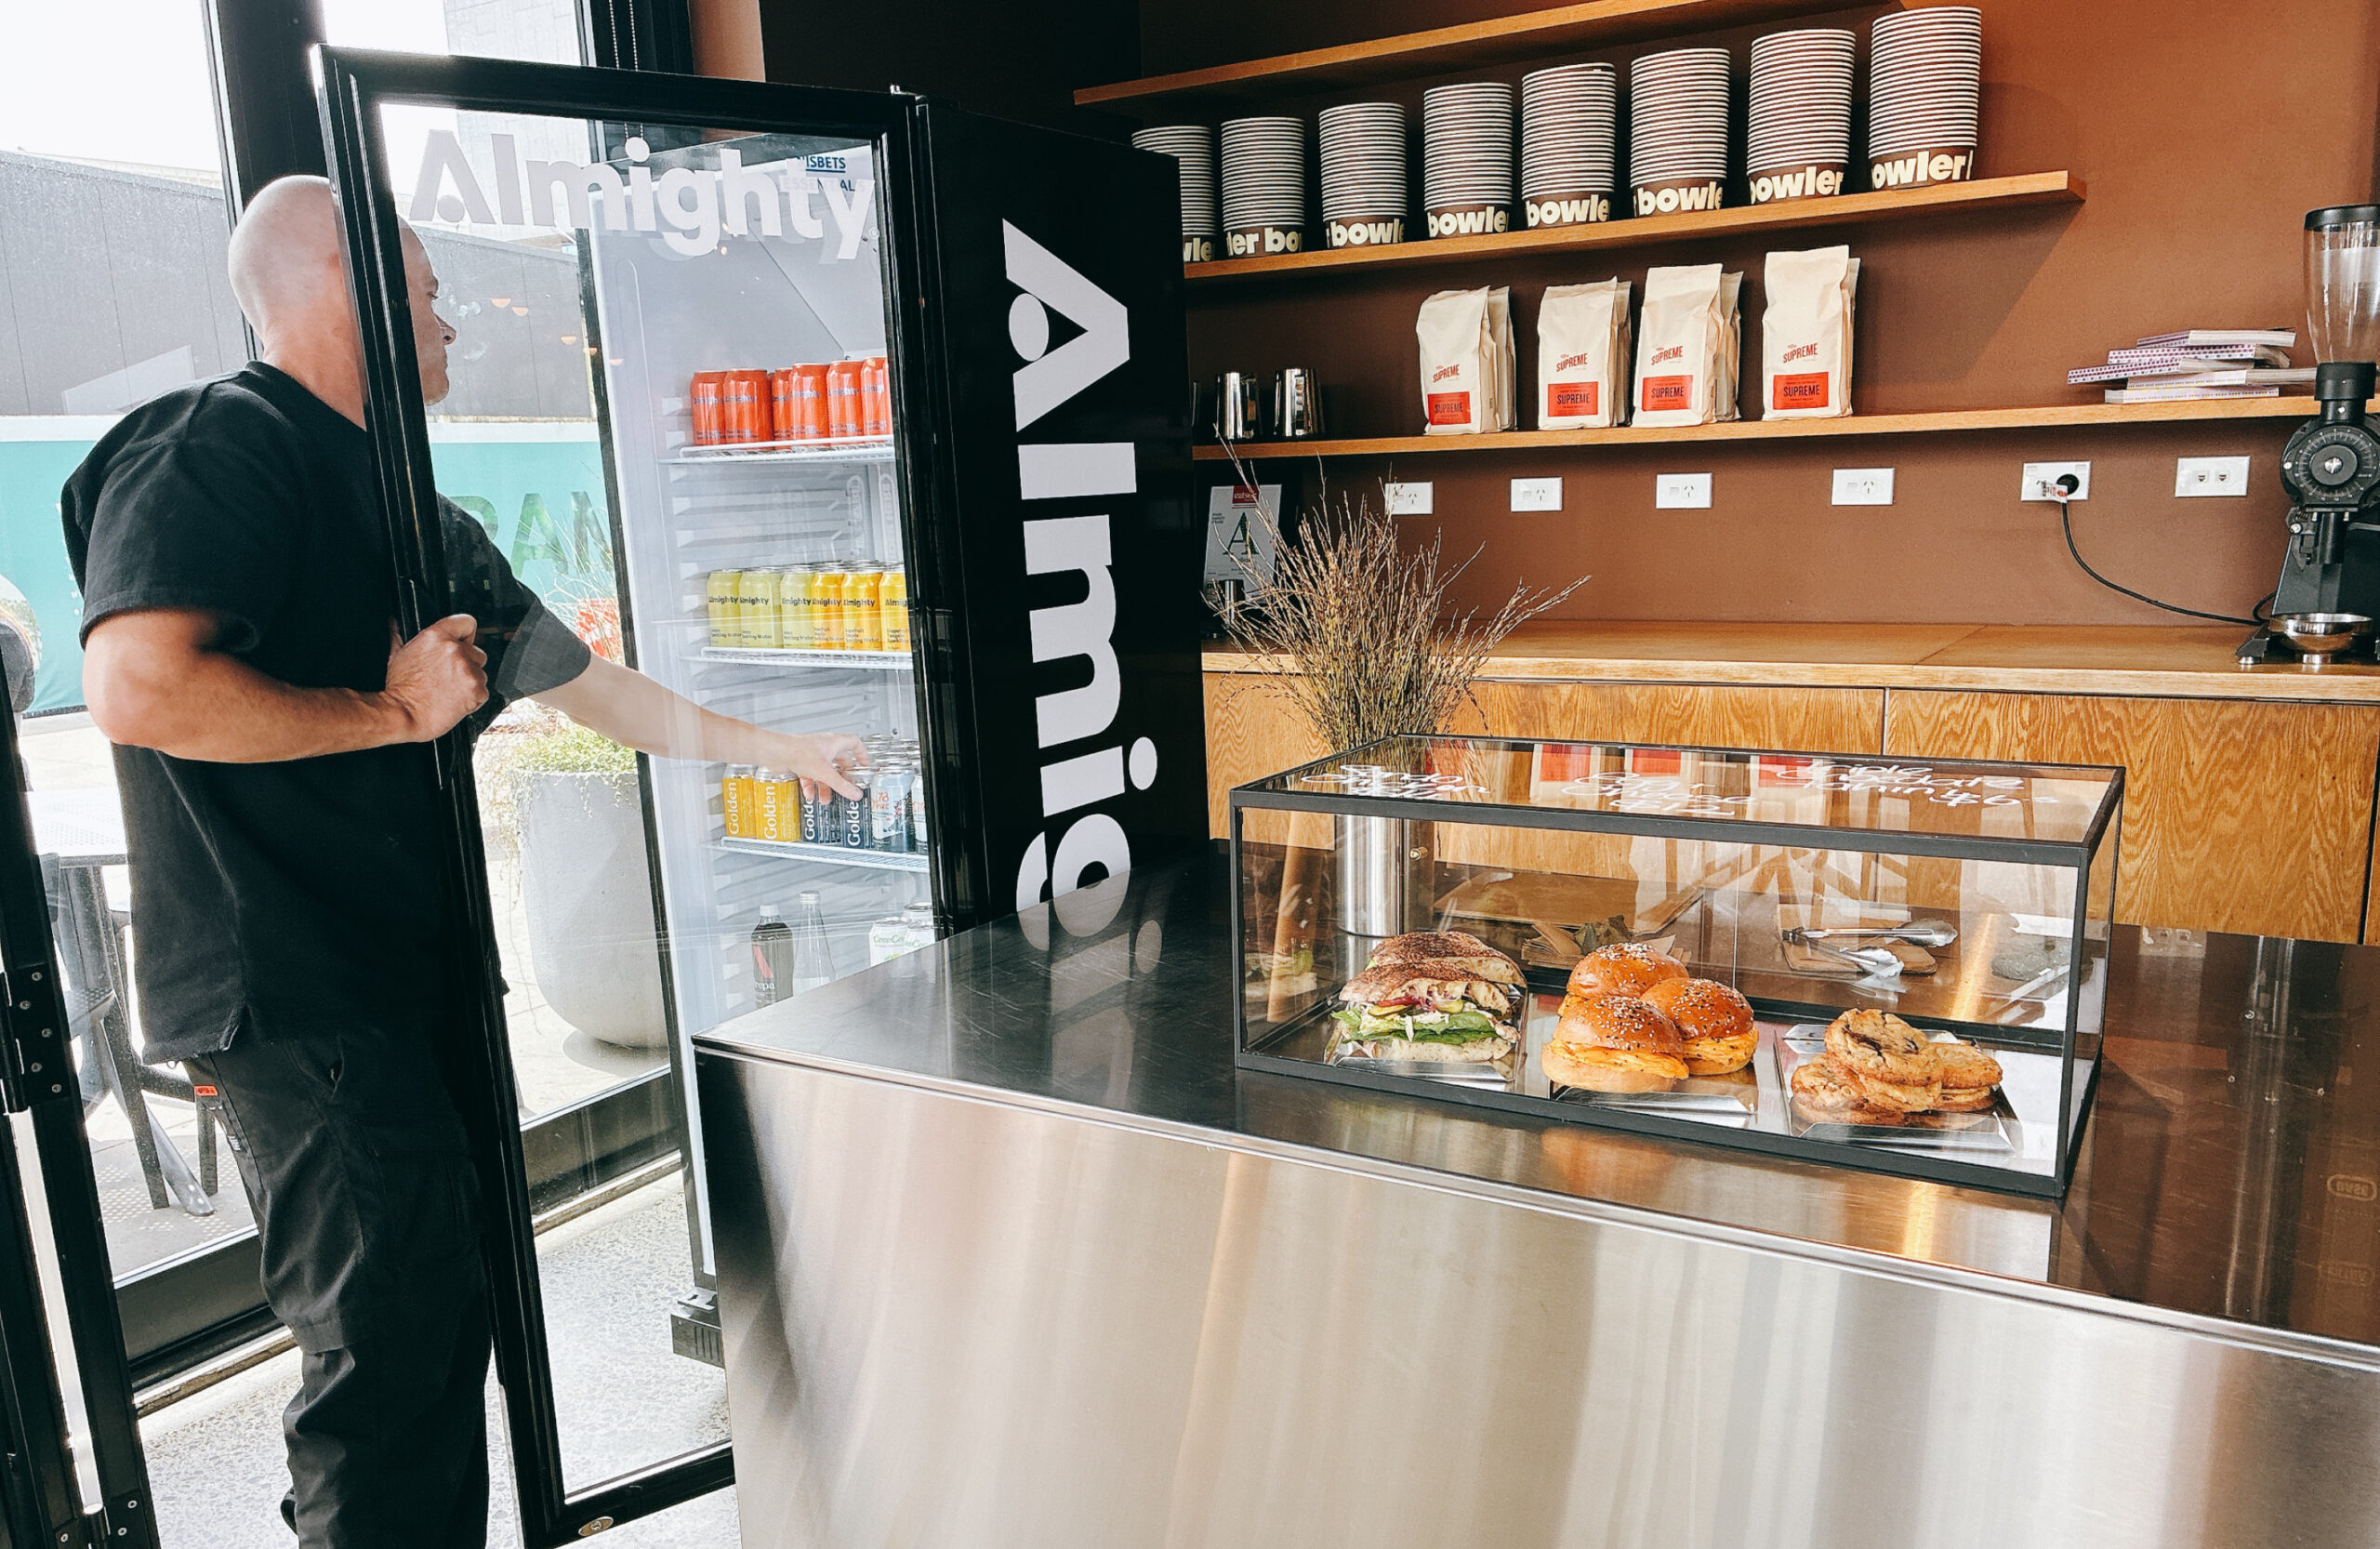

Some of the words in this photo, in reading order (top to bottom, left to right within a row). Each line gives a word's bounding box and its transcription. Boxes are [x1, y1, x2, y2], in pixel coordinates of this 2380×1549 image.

[802, 154, 847, 170] ISBETS
[1871, 151, 1965, 190] owler
[410, 128, 876, 260] Almighty
[1556, 352, 1589, 373] SUPREME
[1650, 345, 1684, 366] SUPREME
[1782, 342, 1819, 364] SUPREME
[1433, 364, 1461, 383] SUPREME
[1556, 392, 1591, 405] SUPREME
[1650, 386, 1685, 399] SUPREME
[1782, 384, 1821, 398] SUPREME
[1435, 402, 1463, 414] SUPREME
[1223, 511, 1260, 555] A
[727, 781, 741, 836] Golden
[762, 785, 778, 841] Golden
[802, 797, 815, 841] Gold
[845, 800, 861, 846] Golde
